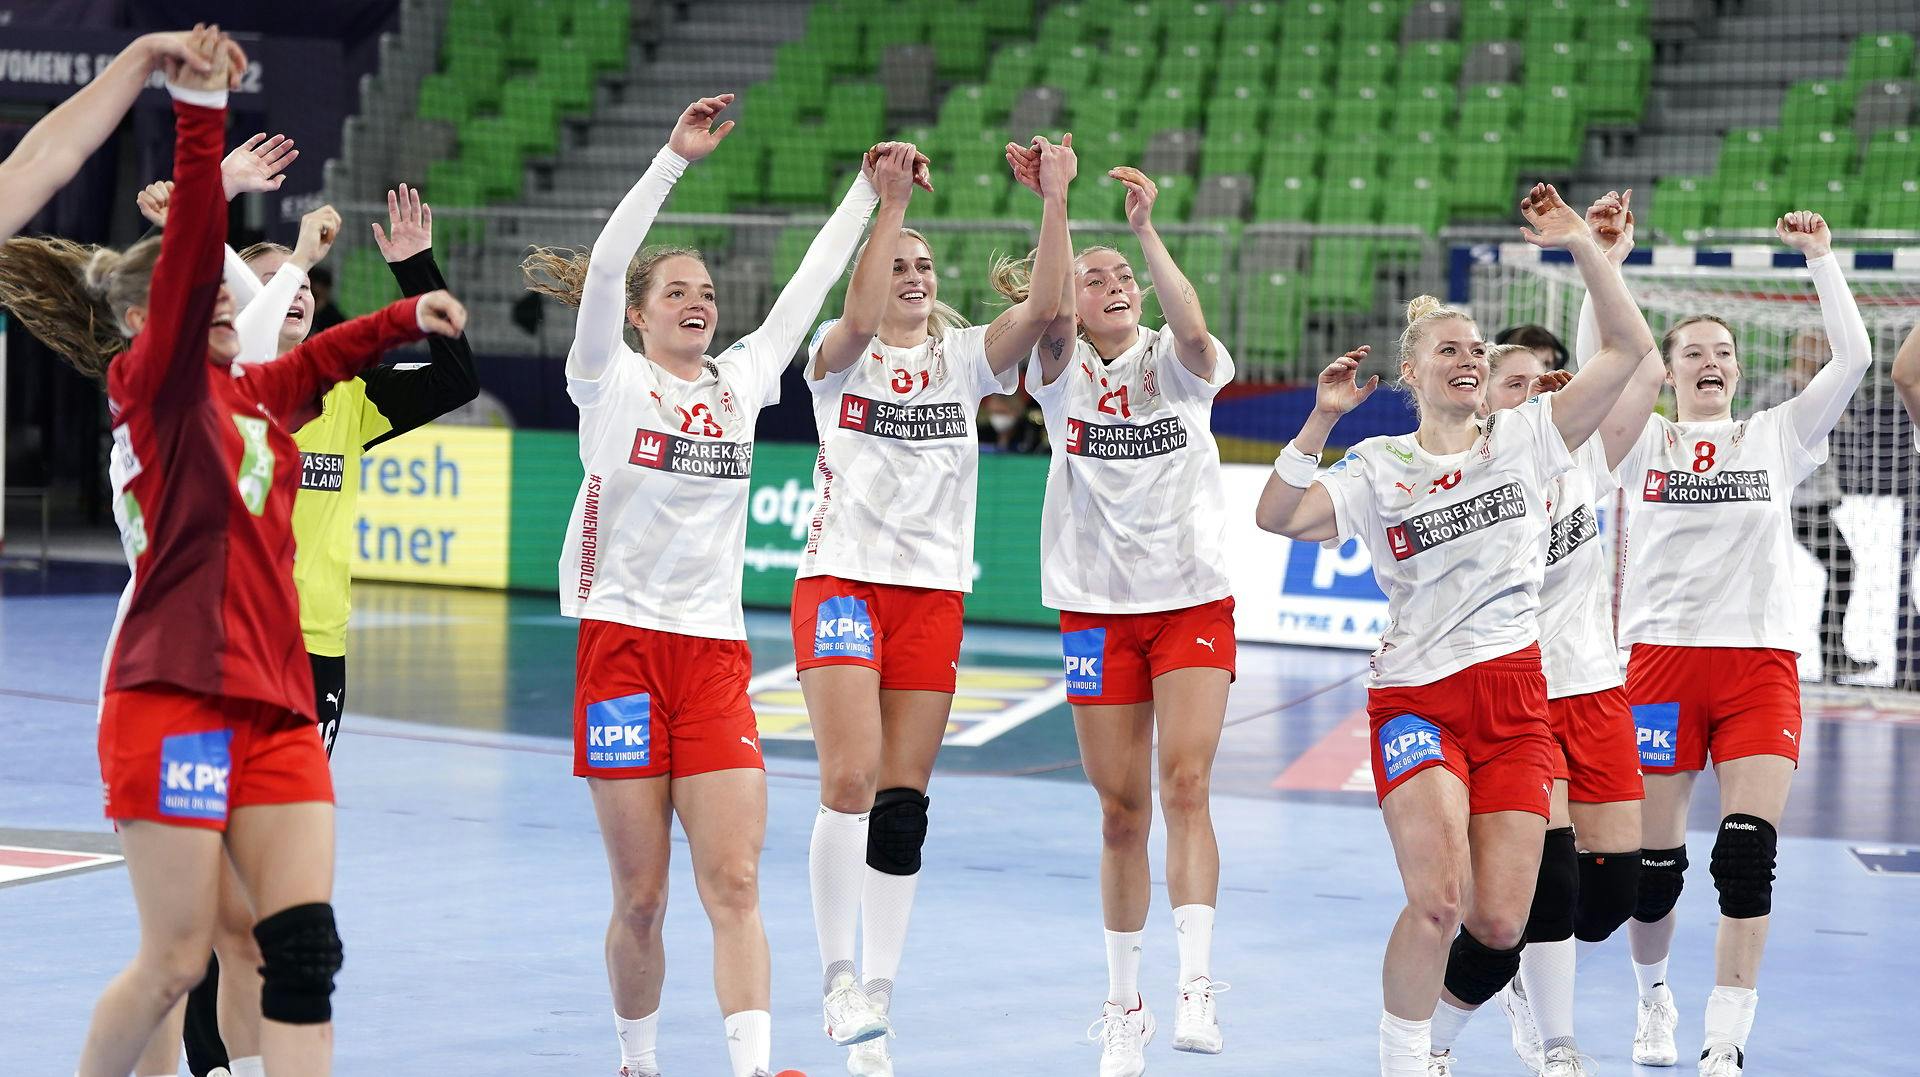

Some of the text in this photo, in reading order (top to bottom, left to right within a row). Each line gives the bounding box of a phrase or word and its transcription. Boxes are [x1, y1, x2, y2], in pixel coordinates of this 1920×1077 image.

[876, 404, 966, 422] SPAREKASSEN
[1098, 384, 1132, 419] 21
[675, 402, 723, 438] 23
[873, 420, 967, 438] KRONJYLLAND
[1088, 417, 1186, 441] SPAREKASSEN
[1088, 432, 1187, 457] KRONJYLLAND
[302, 456, 343, 472] ASSEN
[1692, 441, 1716, 473] 8
[301, 472, 342, 488] LLAND
[361, 444, 460, 498] resh
[1668, 486, 1771, 501] KRONJYLLAND
[1412, 484, 1523, 532] SPAREKASSEN
[1418, 500, 1526, 548] KRONJYLLAND
[354, 516, 456, 565] tner
[577, 474, 602, 602] #SAMMENFORHOLDET
[819, 617, 870, 641] KPK
[1064, 655, 1098, 677] PK
[590, 725, 644, 747] KPK
[1384, 730, 1438, 762] KPK
[1635, 727, 1671, 748] PK
[614, 750, 645, 761] VINDUER
